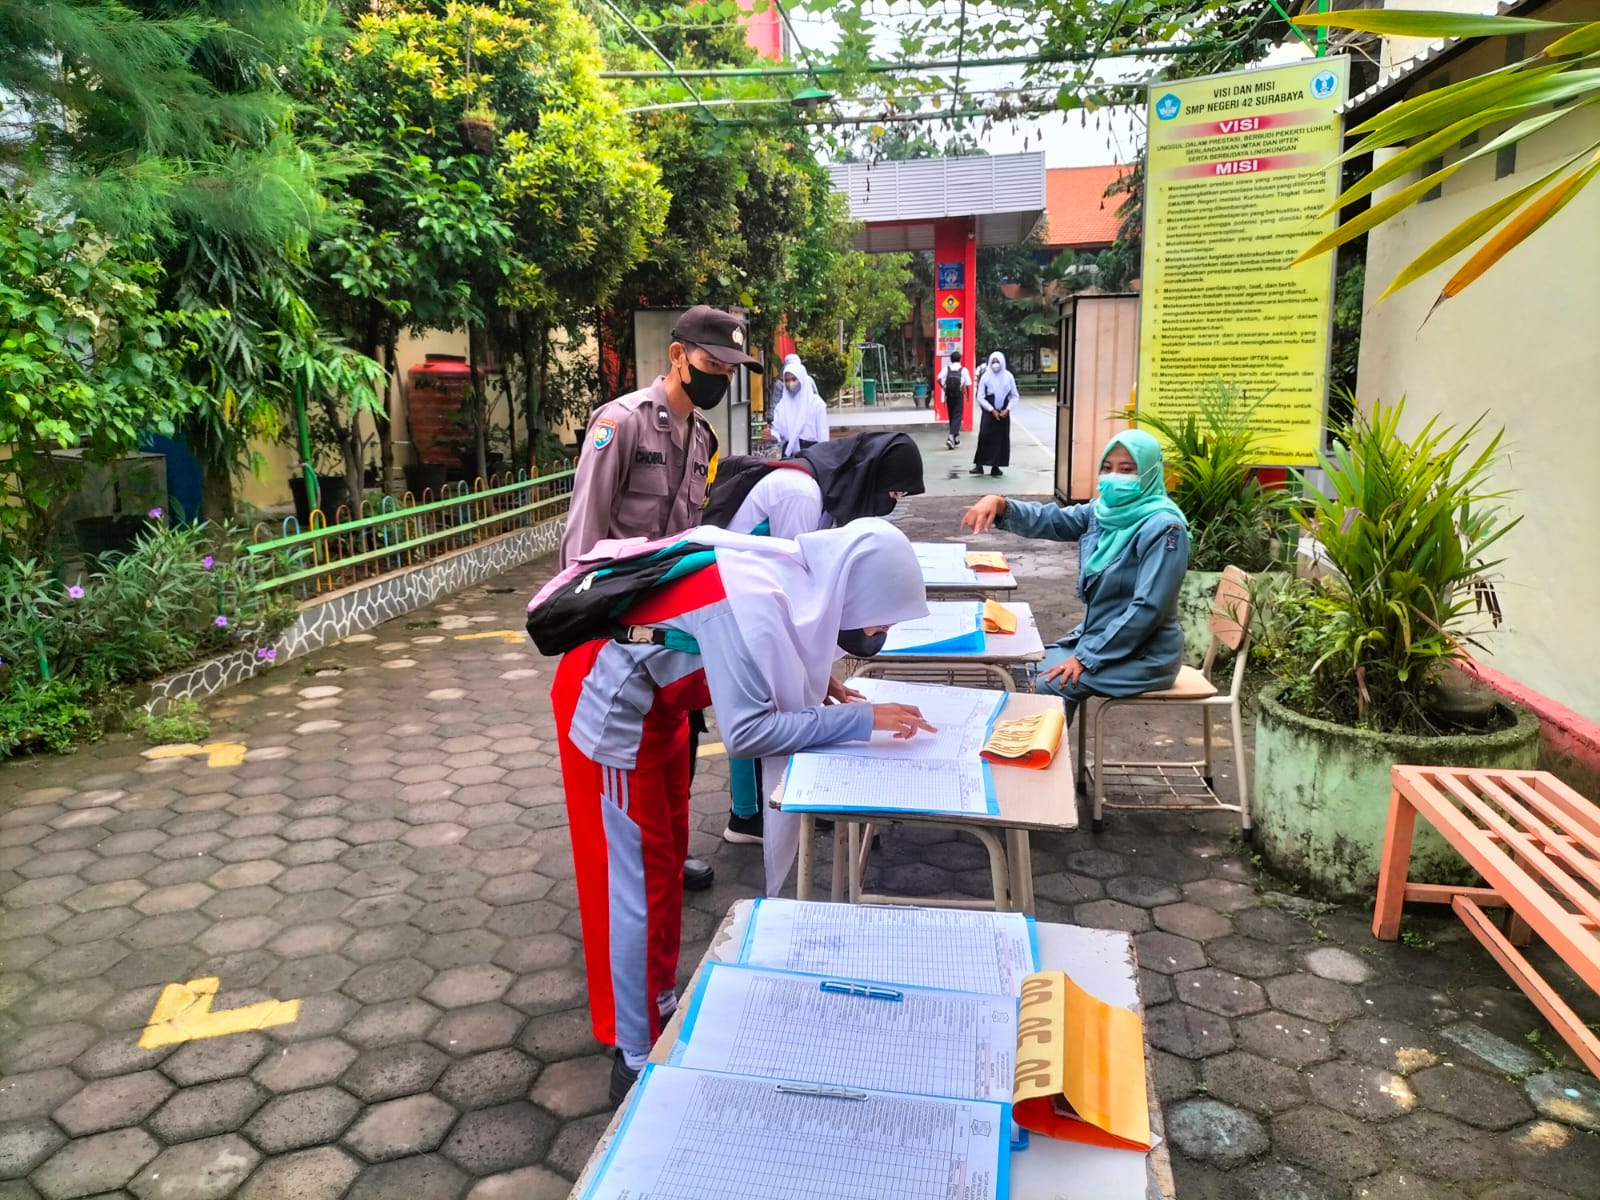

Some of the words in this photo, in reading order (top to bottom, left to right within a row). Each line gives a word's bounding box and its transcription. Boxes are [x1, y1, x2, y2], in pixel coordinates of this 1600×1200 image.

[1213, 87, 1231, 98] VISI
[1233, 84, 1252, 96] DAN
[1254, 81, 1275, 93] MISI
[1185, 104, 1204, 115] SMP
[1207, 99, 1240, 112] NEGERI
[1242, 96, 1253, 107] 42
[1255, 90, 1304, 106] SURABAYA
[1219, 117, 1259, 134] VISI
[1185, 139, 1208, 148] DALAM
[1243, 131, 1275, 141] BERBUDI
[1275, 127, 1305, 137] PEKERTI
[1186, 143, 1240, 156] BERLANDASKAN
[1241, 141, 1261, 150] IMTAK
[1262, 139, 1277, 148] DAN
[1278, 136, 1299, 146] IPTEK
[1188, 153, 1208, 162] SERTA
[1209, 150, 1250, 160] BERBUDAYA
[1250, 145, 1297, 156] LINGKUNGAN
[1215, 159, 1258, 175] MISI
